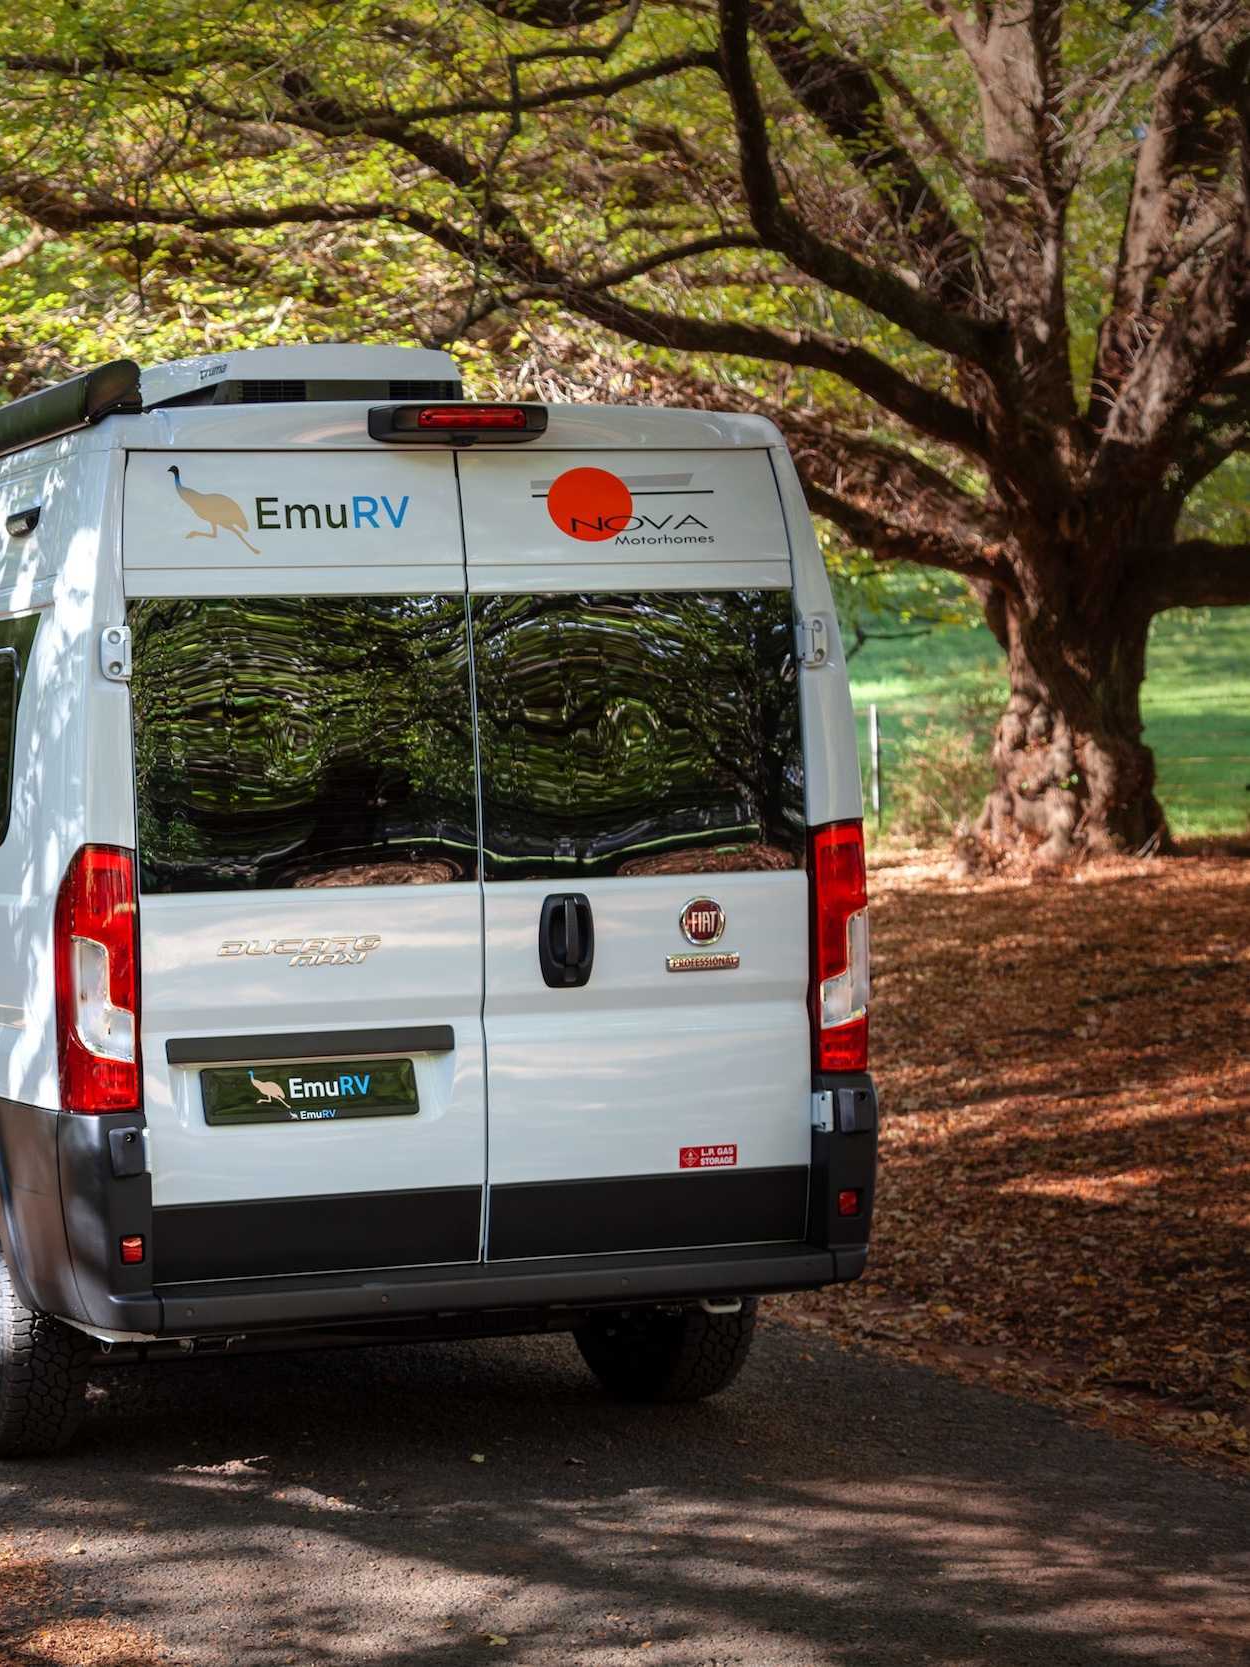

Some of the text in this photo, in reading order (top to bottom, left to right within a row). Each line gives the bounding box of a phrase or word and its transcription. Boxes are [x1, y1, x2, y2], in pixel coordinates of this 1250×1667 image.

[255, 495, 410, 530] EmuRV
[571, 514, 708, 533] NOVA
[615, 534, 715, 546] Motorhomes
[691, 911, 717, 933] FIAT
[217, 935, 382, 956] DUCATO
[288, 951, 367, 967] MAXI
[672, 956, 737, 968] PROFESSIONAL
[289, 1075, 370, 1098] EmuRV
[300, 1109, 336, 1119] EmuRV
[717, 1147, 734, 1155] GAS
[701, 1156, 734, 1165] STORAGE
